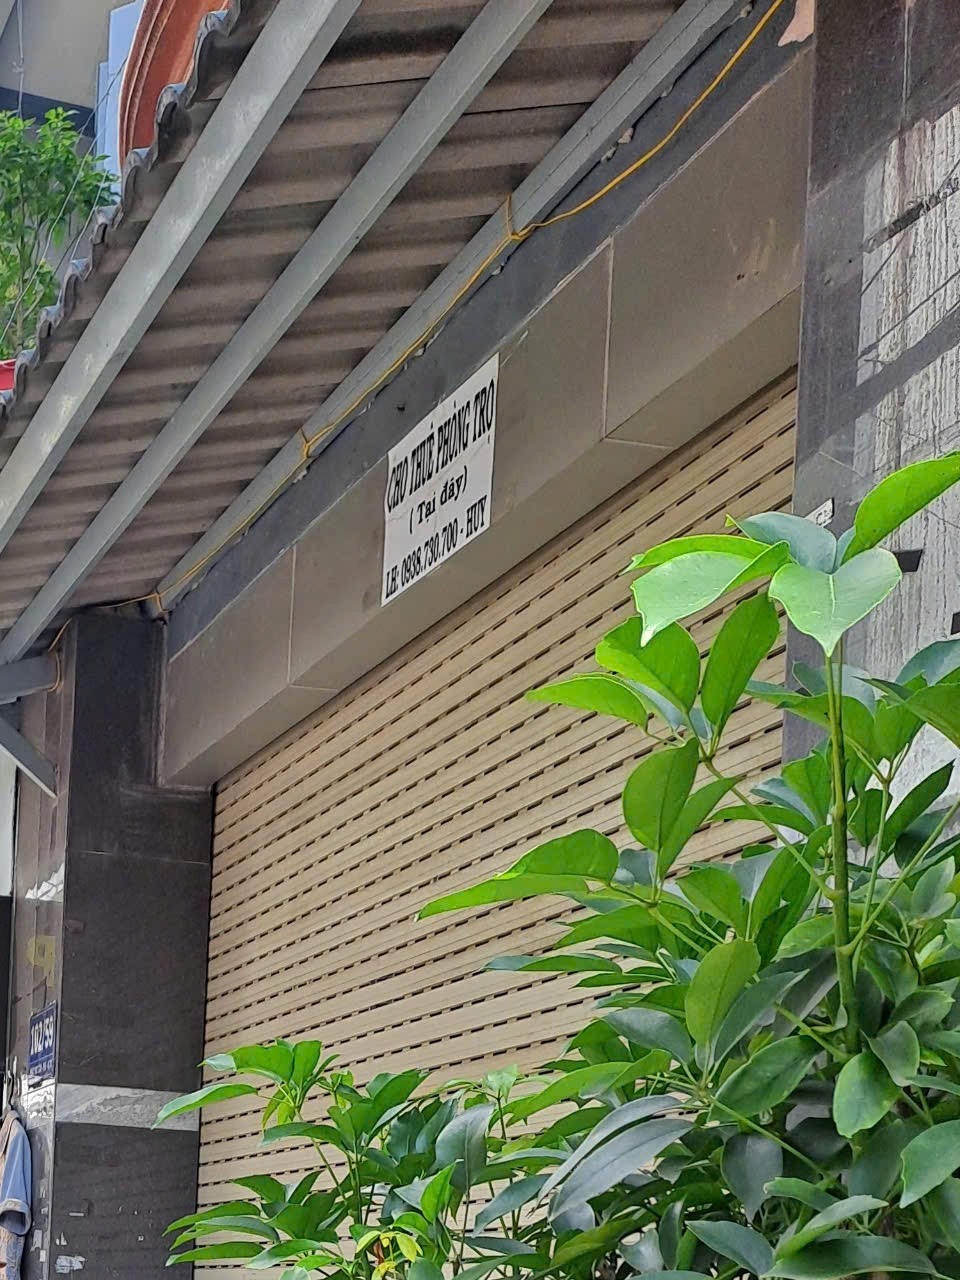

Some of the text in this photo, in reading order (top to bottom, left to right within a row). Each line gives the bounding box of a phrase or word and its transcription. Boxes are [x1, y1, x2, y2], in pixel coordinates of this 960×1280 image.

[386, 462, 408, 514] CHO
[435, 400, 471, 475] PHÒNG
[471, 378, 495, 445] TRỌ
[385, 564, 401, 599] LH:
[400, 517, 459, 586] 0938.730.700
[465, 494, 488, 539] HUY
